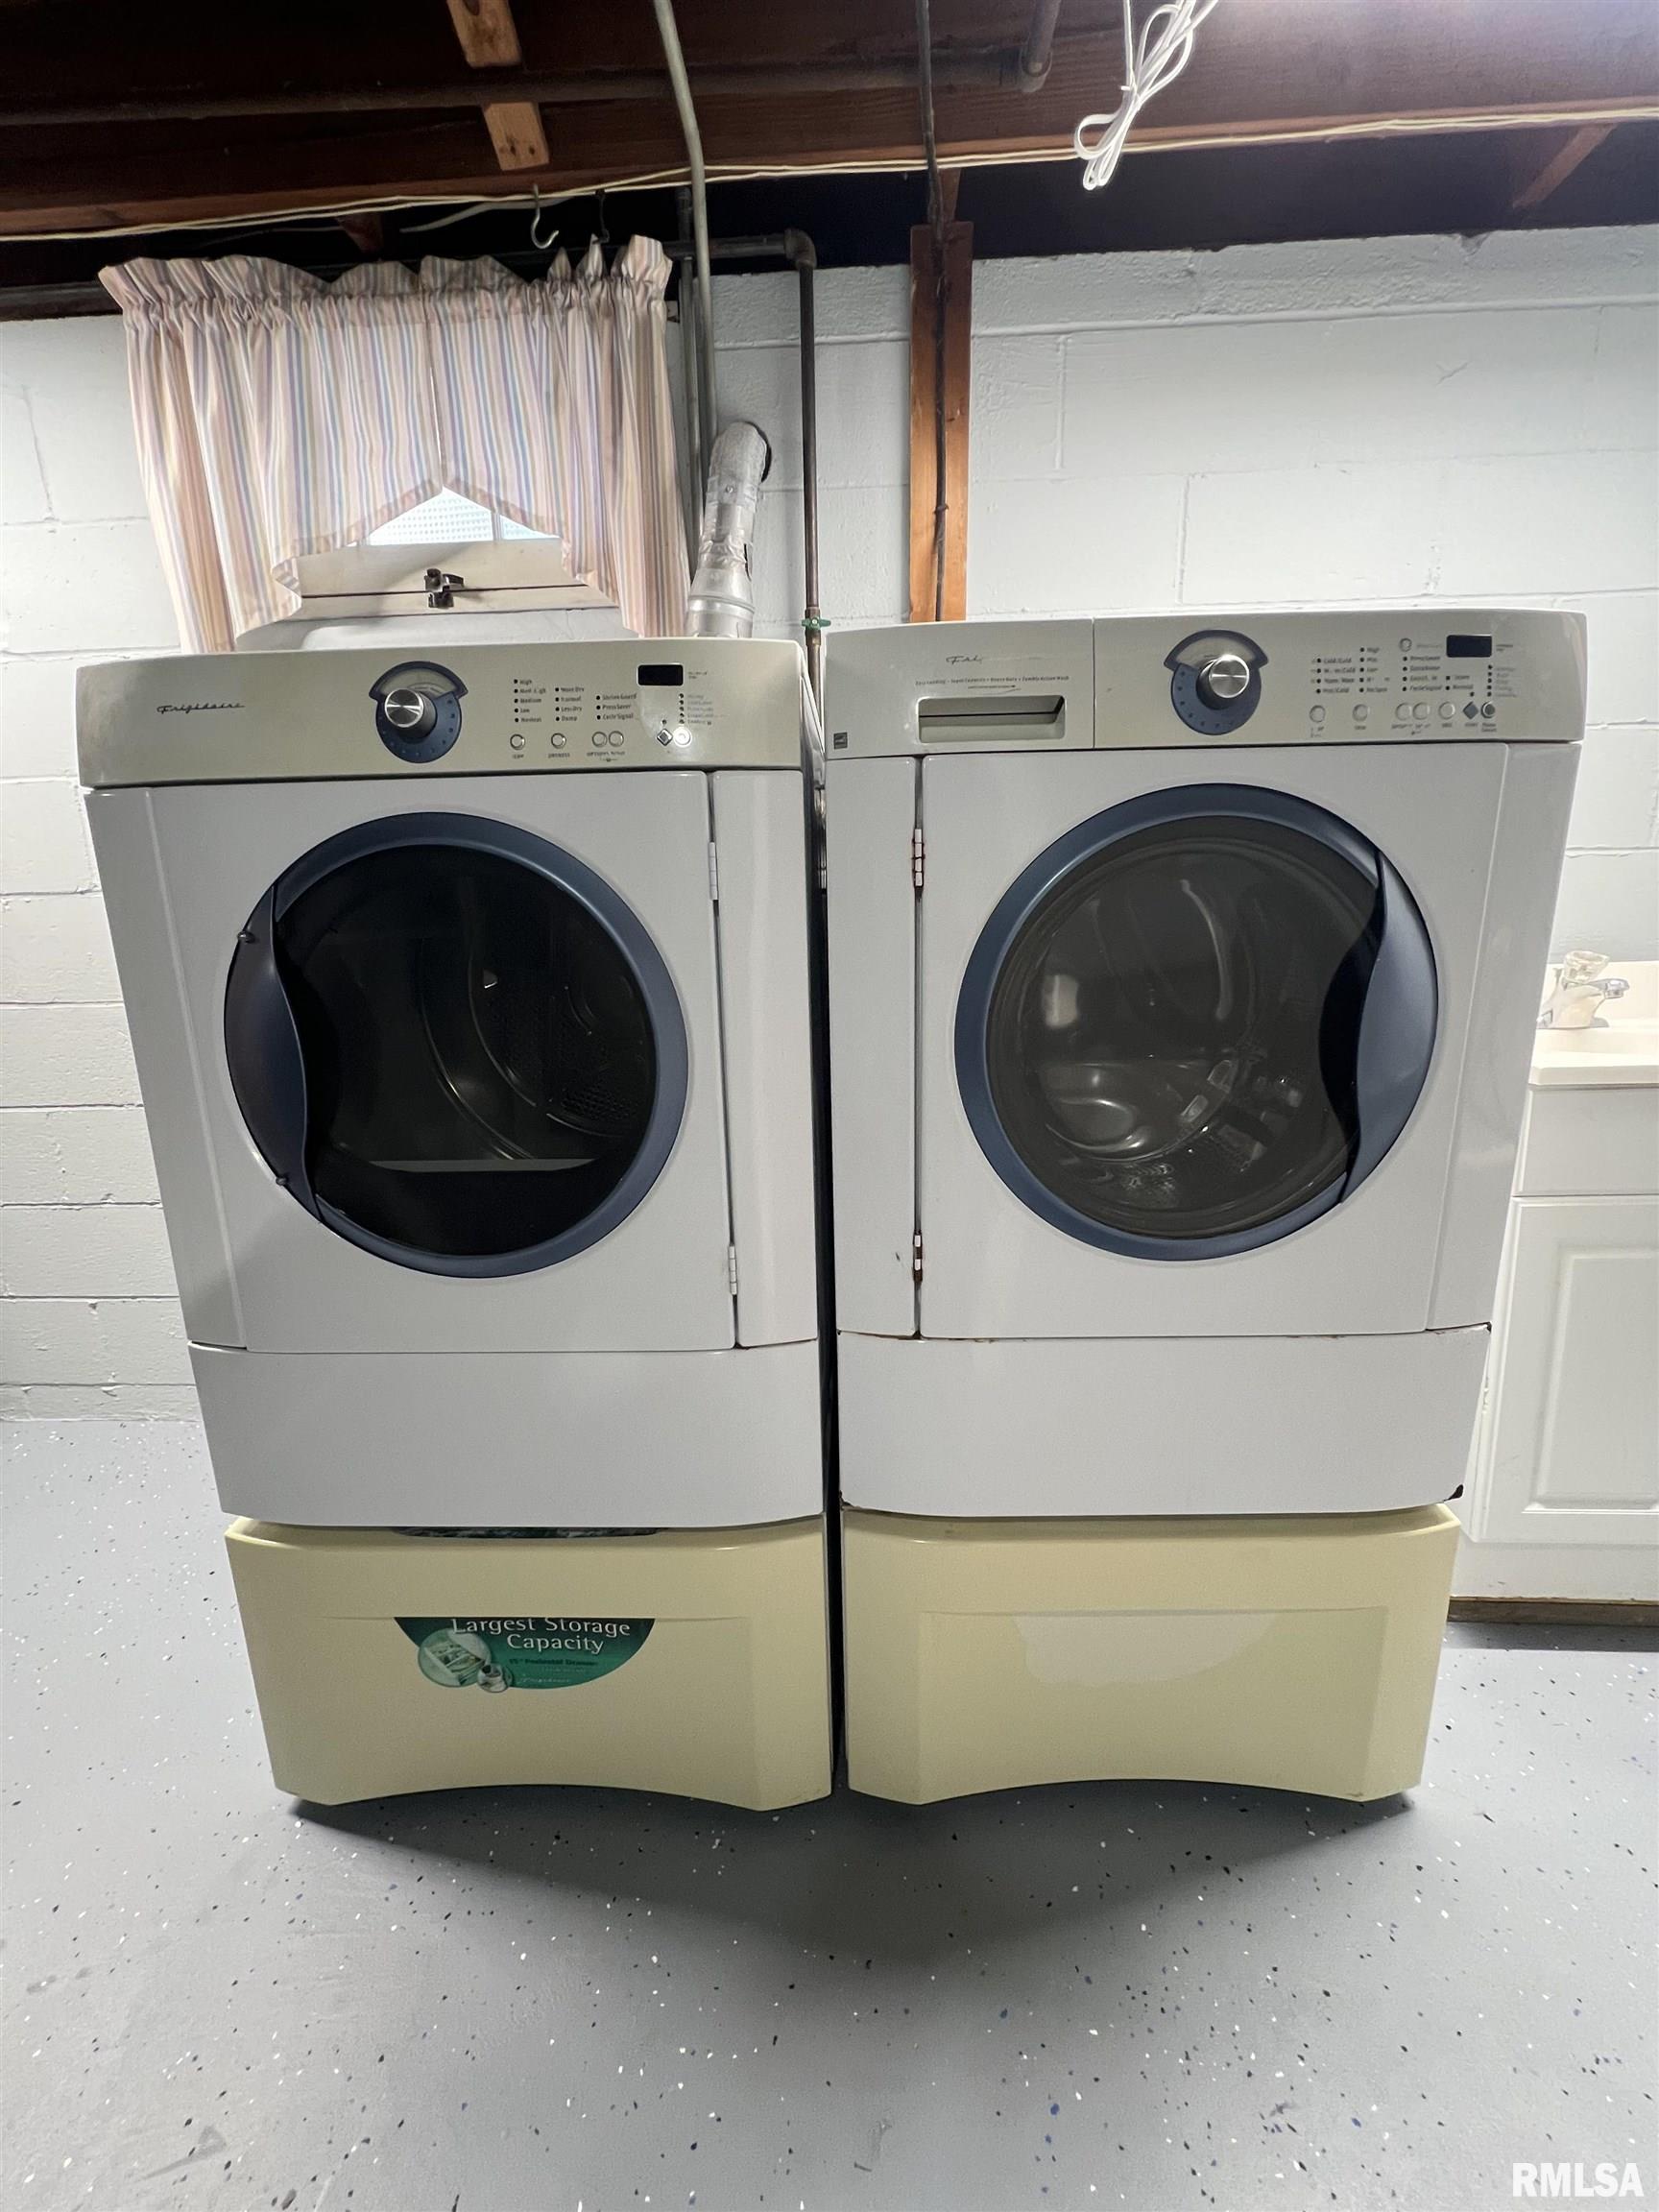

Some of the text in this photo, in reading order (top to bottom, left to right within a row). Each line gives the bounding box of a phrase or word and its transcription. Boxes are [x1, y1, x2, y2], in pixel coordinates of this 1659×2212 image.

[452, 1618, 632, 1638] Largest Storage
[507, 1634, 604, 1655] Capacity
